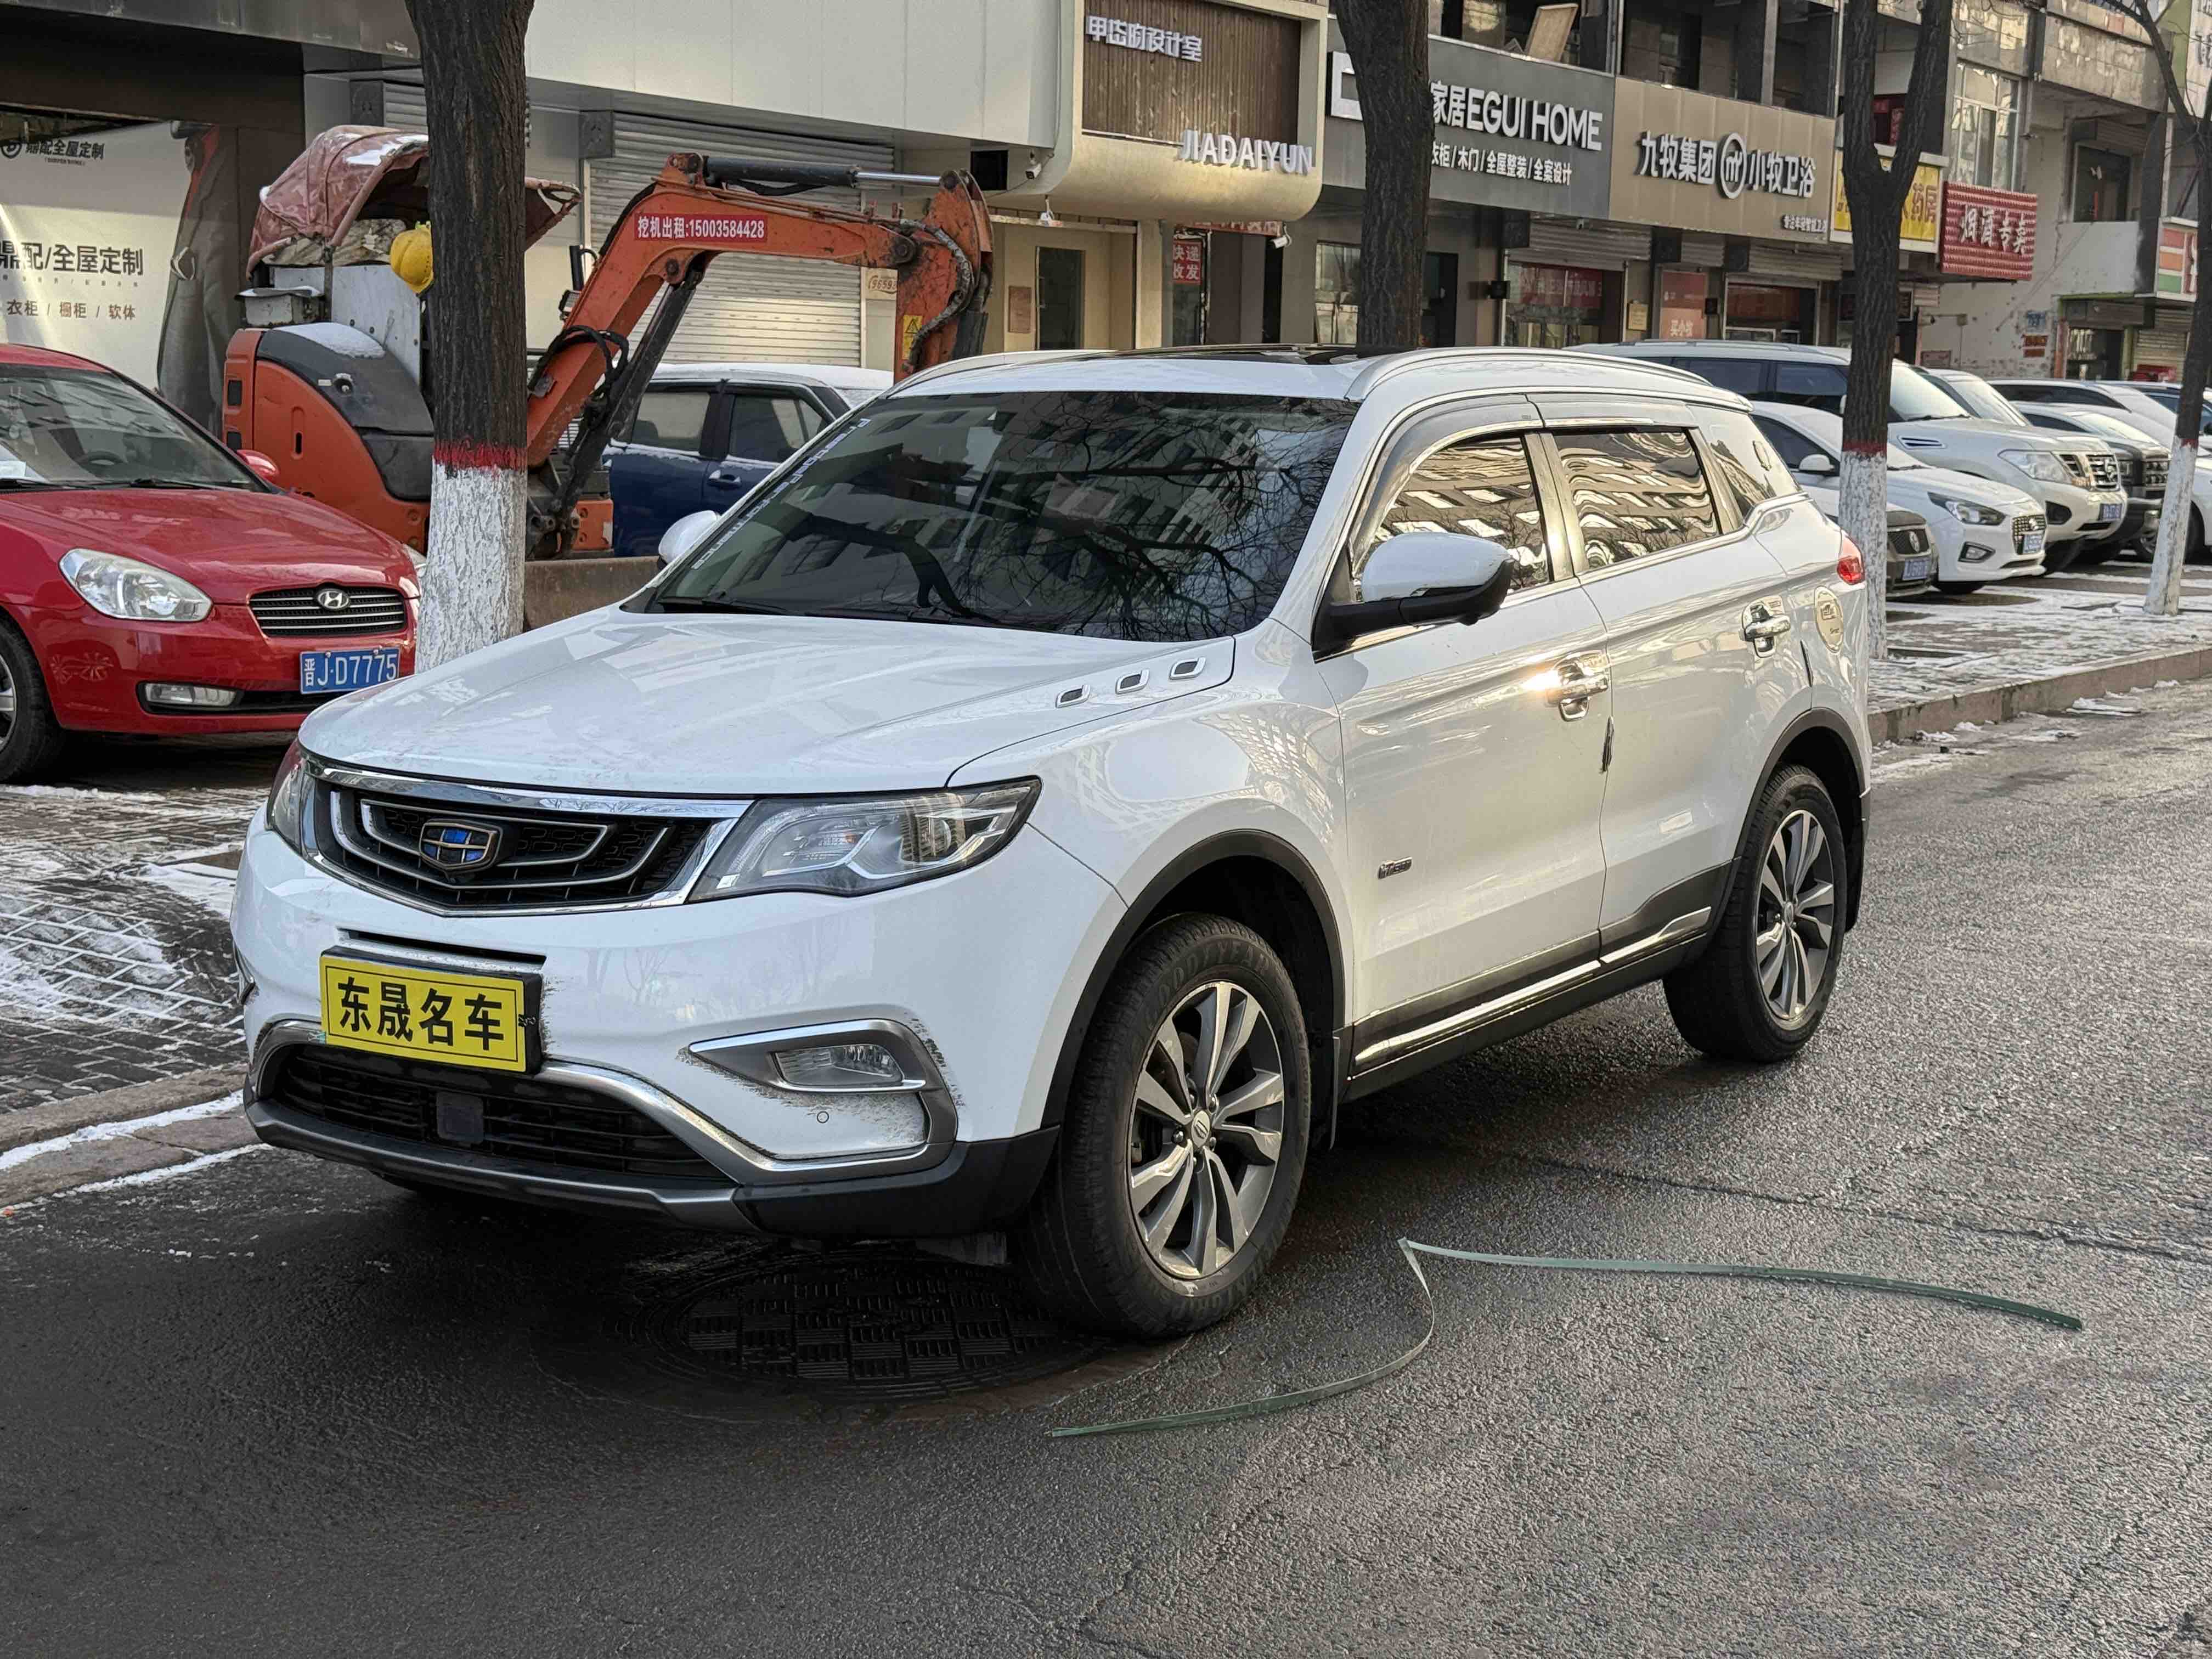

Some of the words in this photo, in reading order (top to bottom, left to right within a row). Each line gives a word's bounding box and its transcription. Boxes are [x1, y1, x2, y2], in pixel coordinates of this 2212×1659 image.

[1531, 100, 1602, 151] HOME
[1180, 129, 1313, 176] JIADAIYUN
[1640, 131, 1718, 185] 九牧集团
[1748, 150, 1816, 198] 小牧卫浴
[1173, 245, 1200, 262] 快递
[1173, 263, 1200, 280] 收发
[7, 299, 38, 317] 衣柜
[109, 304, 136, 320] 软体
[337, 976, 504, 1051] 东晟名车
